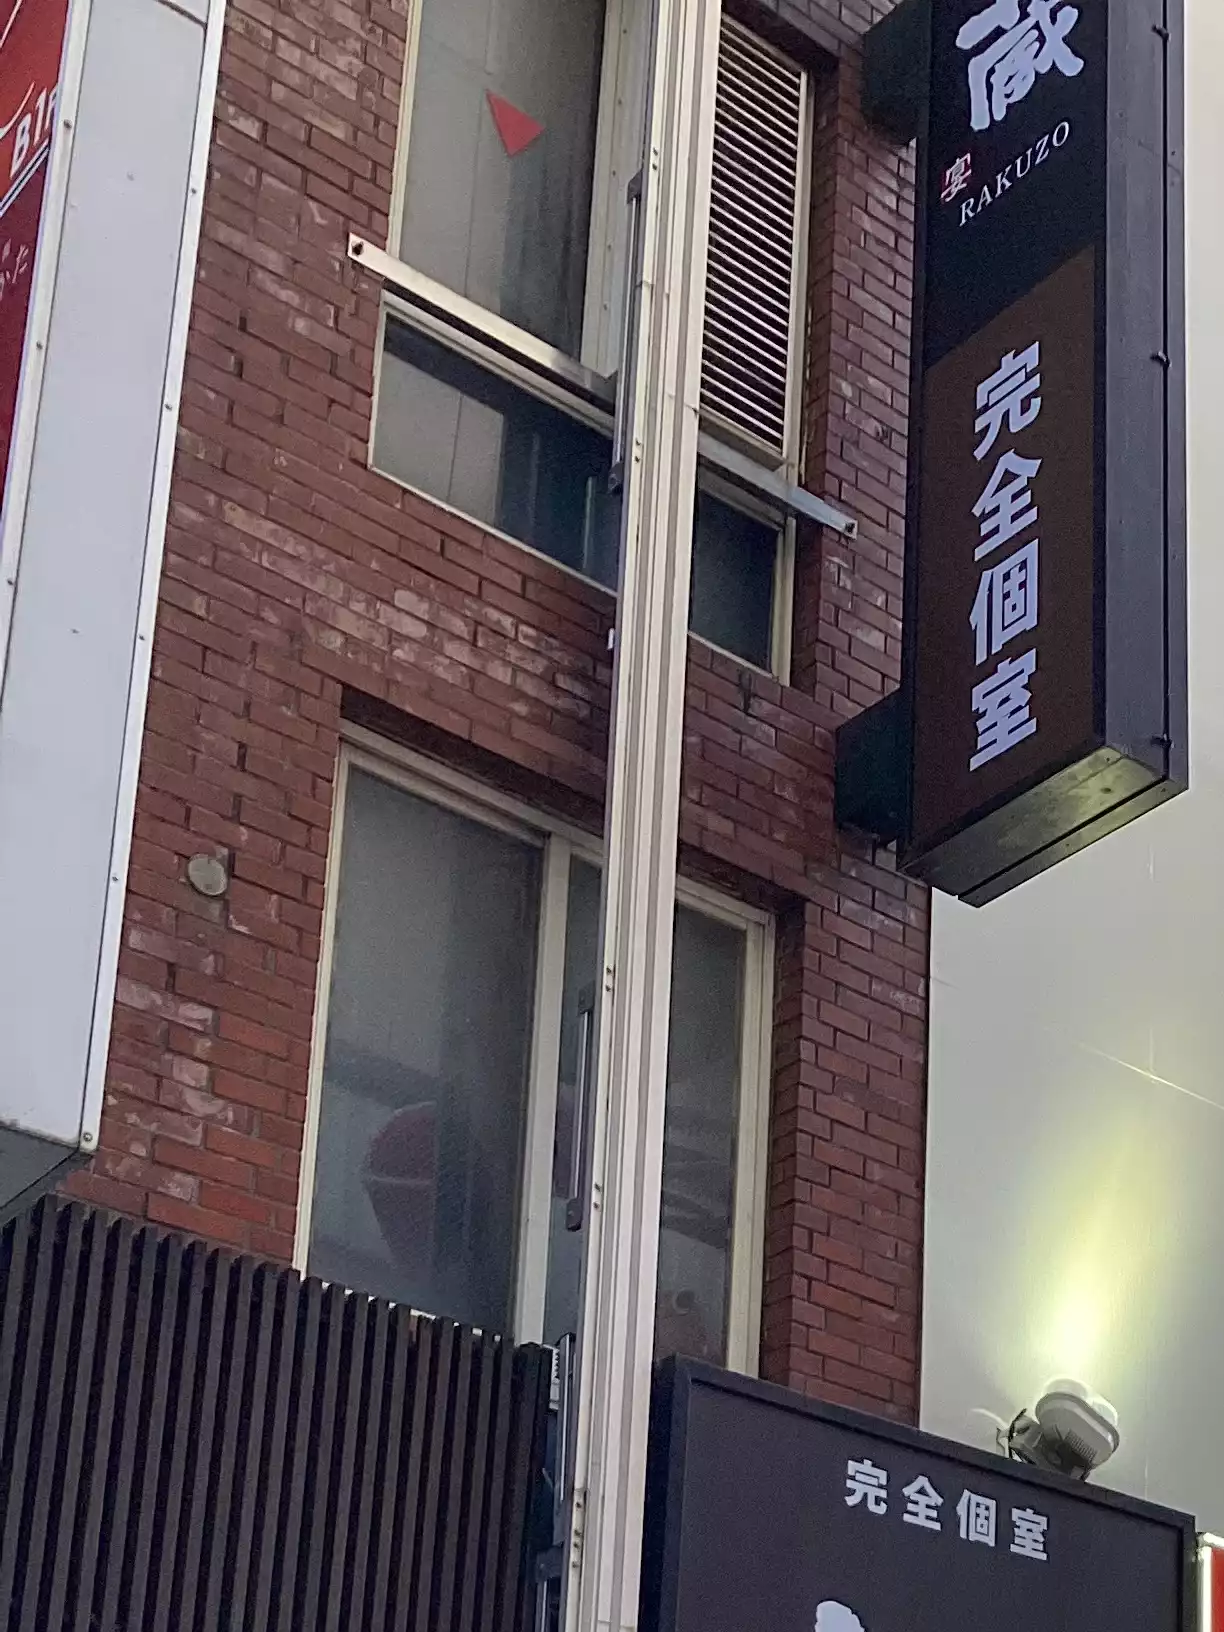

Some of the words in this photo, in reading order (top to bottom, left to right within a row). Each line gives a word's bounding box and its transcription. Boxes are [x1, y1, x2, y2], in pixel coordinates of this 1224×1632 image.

[959, 121, 1070, 227] RAKUZO
[969, 341, 1043, 772] 完全個室
[845, 1458, 1050, 1562] 完全個室
